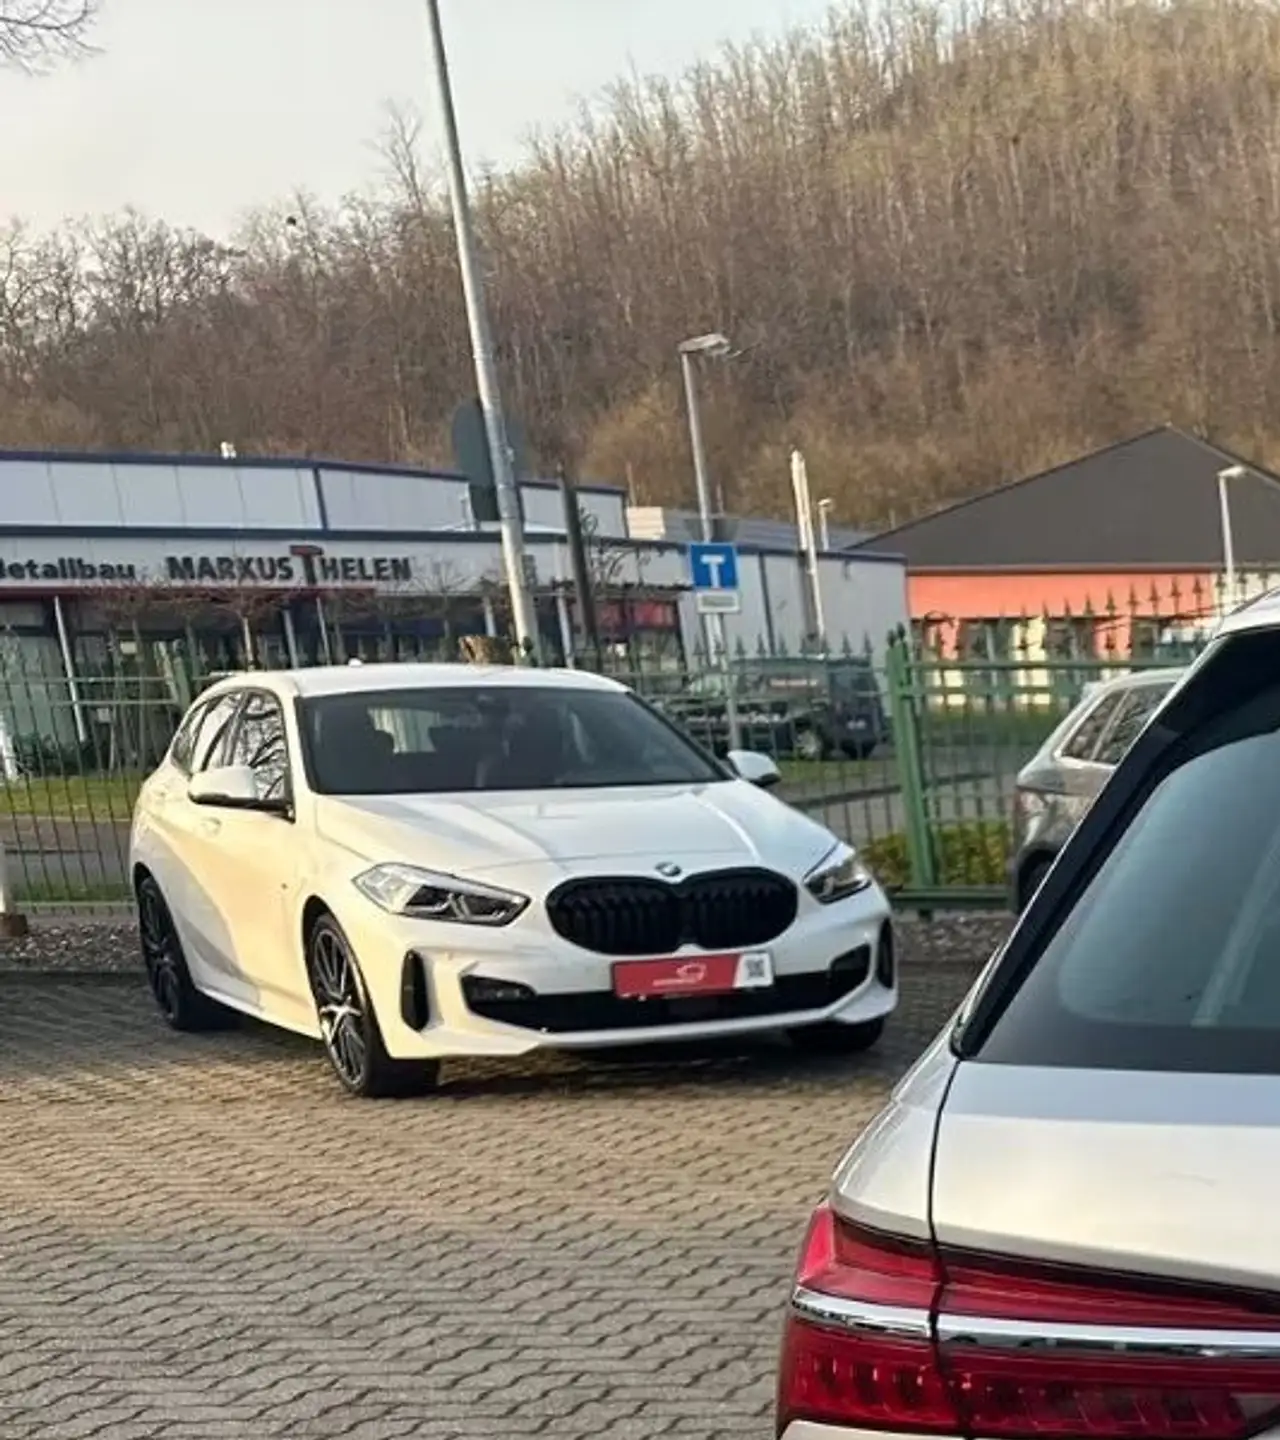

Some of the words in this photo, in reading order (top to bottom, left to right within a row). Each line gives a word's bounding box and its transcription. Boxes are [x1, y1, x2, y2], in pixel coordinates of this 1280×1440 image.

[0, 557, 135, 580] etallbau
[165, 556, 294, 580] MARKUS
[289, 545, 412, 586] THELEN
